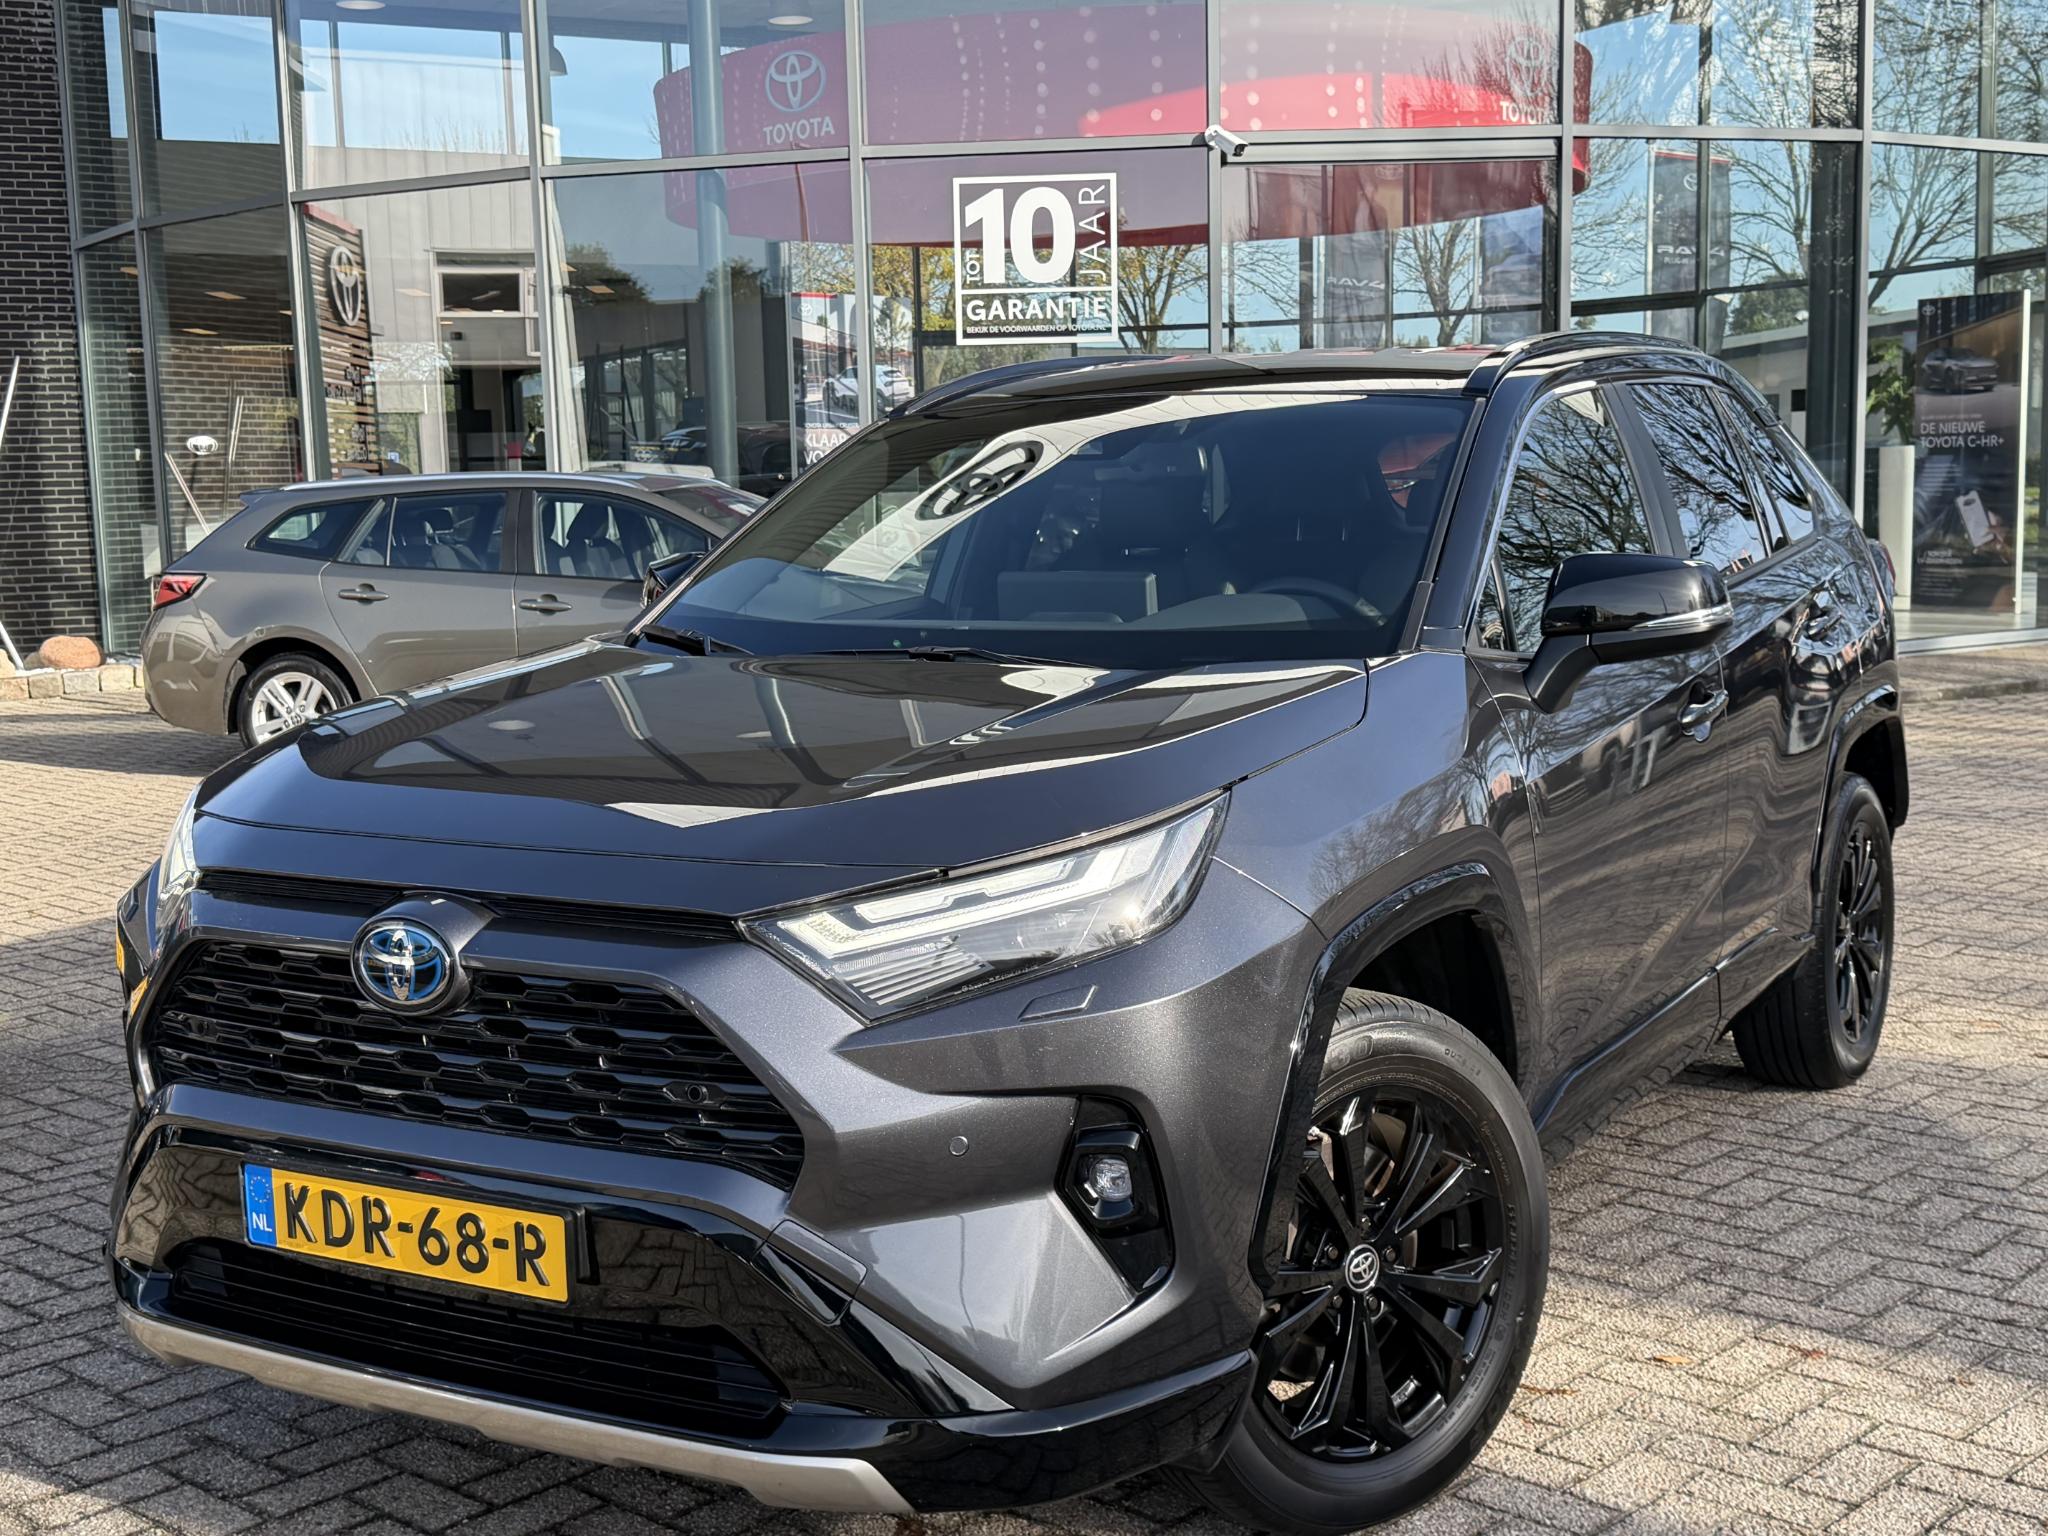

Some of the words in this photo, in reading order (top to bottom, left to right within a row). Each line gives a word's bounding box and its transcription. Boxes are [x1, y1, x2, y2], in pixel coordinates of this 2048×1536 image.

[763, 116, 835, 145] TOYOTA
[964, 186, 1076, 284] 10
[1078, 184, 1106, 282] JAAR
[966, 250, 981, 284] TOT
[966, 296, 1107, 321] GARANTIE
[989, 326, 999, 334] DE
[999, 325, 1056, 333] VOORWAARDEN
[1056, 324, 1068, 332] OP
[1920, 422, 1936, 434] DE
[1939, 421, 1986, 434] NIEUWE
[1920, 435, 1965, 448] TOYOTA
[1967, 434, 2005, 448] C-HR+
[252, 1211, 273, 1232] NL
[284, 1182, 551, 1287] KDR-68-R
